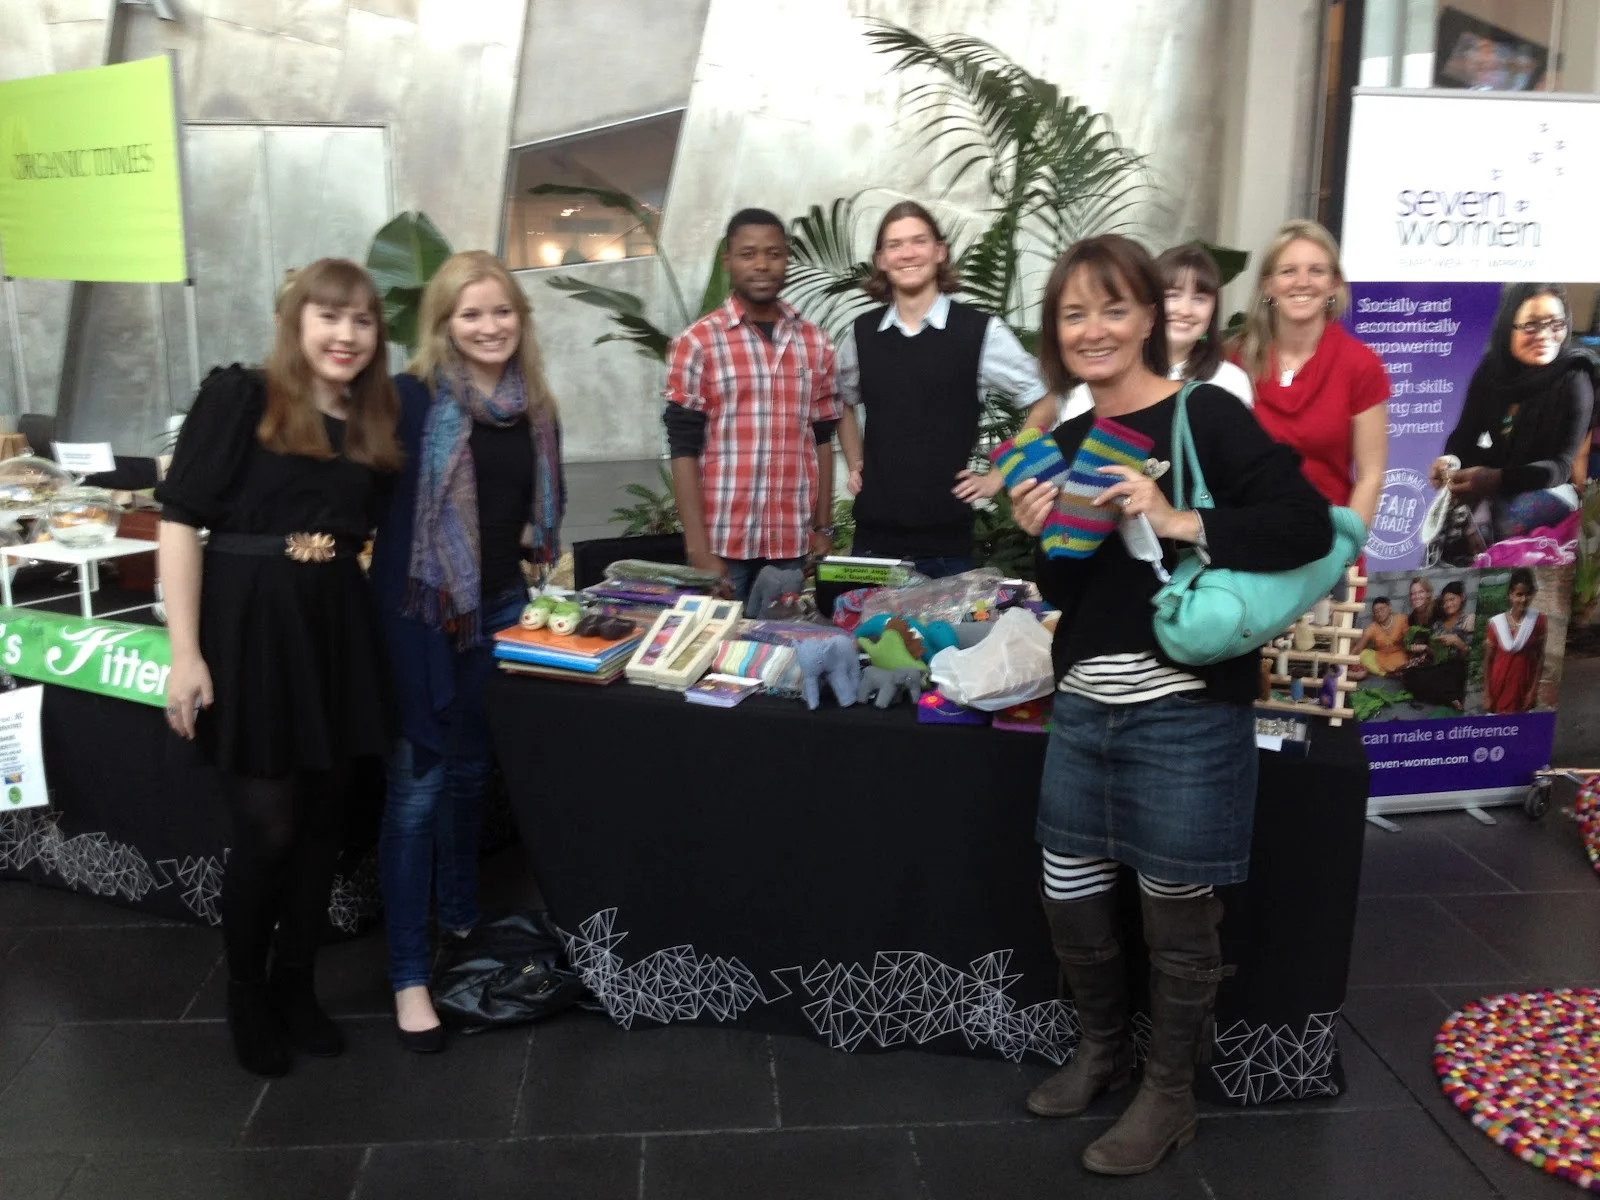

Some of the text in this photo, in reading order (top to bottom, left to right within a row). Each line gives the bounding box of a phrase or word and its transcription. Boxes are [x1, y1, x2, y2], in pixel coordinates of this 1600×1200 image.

[91, 143, 154, 176] TIMES
[1397, 190, 1506, 218] seven
[1397, 220, 1542, 248] women
[1357, 297, 1452, 316] Socially and
[1355, 318, 1461, 336] economically
[1415, 379, 1454, 394] skills
[1411, 399, 1442, 414] and
[1378, 493, 1418, 518] FAIR
[1373, 514, 1413, 534] TRADE
[1362, 725, 1519, 745] can make a difference
